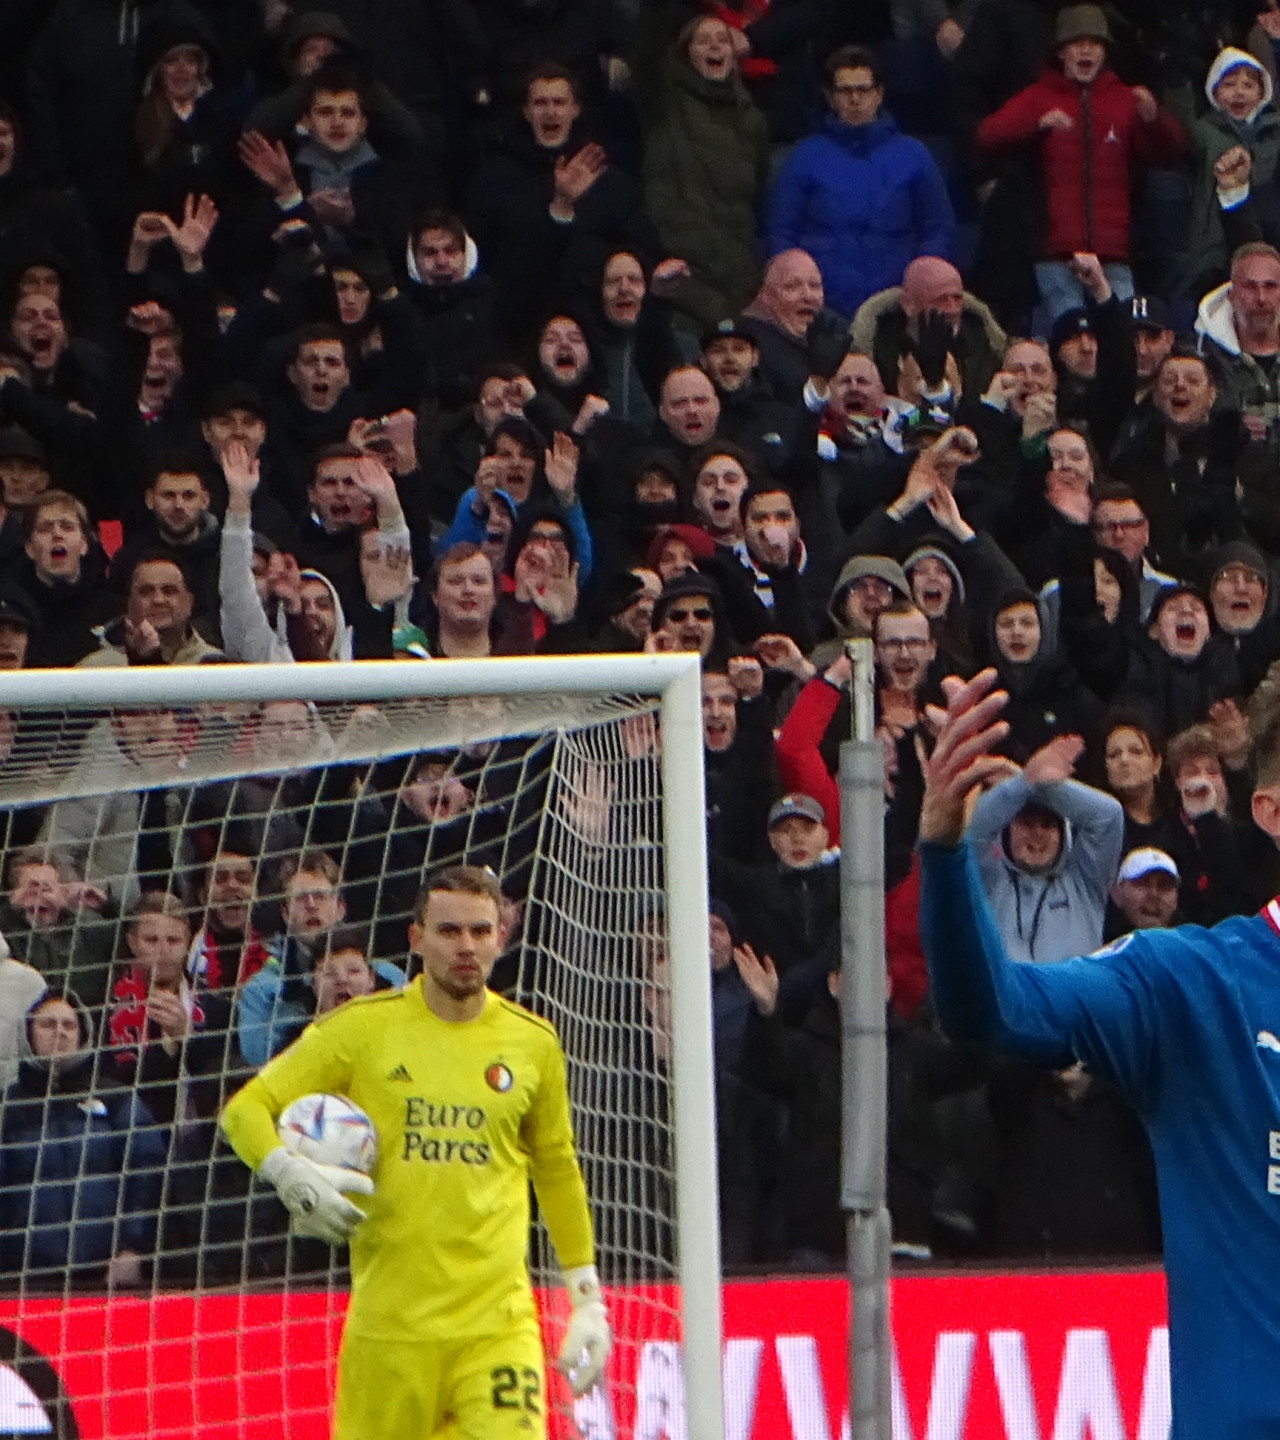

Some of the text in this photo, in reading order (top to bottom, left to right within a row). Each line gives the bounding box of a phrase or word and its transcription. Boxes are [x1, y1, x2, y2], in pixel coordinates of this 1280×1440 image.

[405, 1097, 486, 1129] Euro
[402, 1131, 490, 1165] Parcs
[490, 1364, 541, 1415] 22
